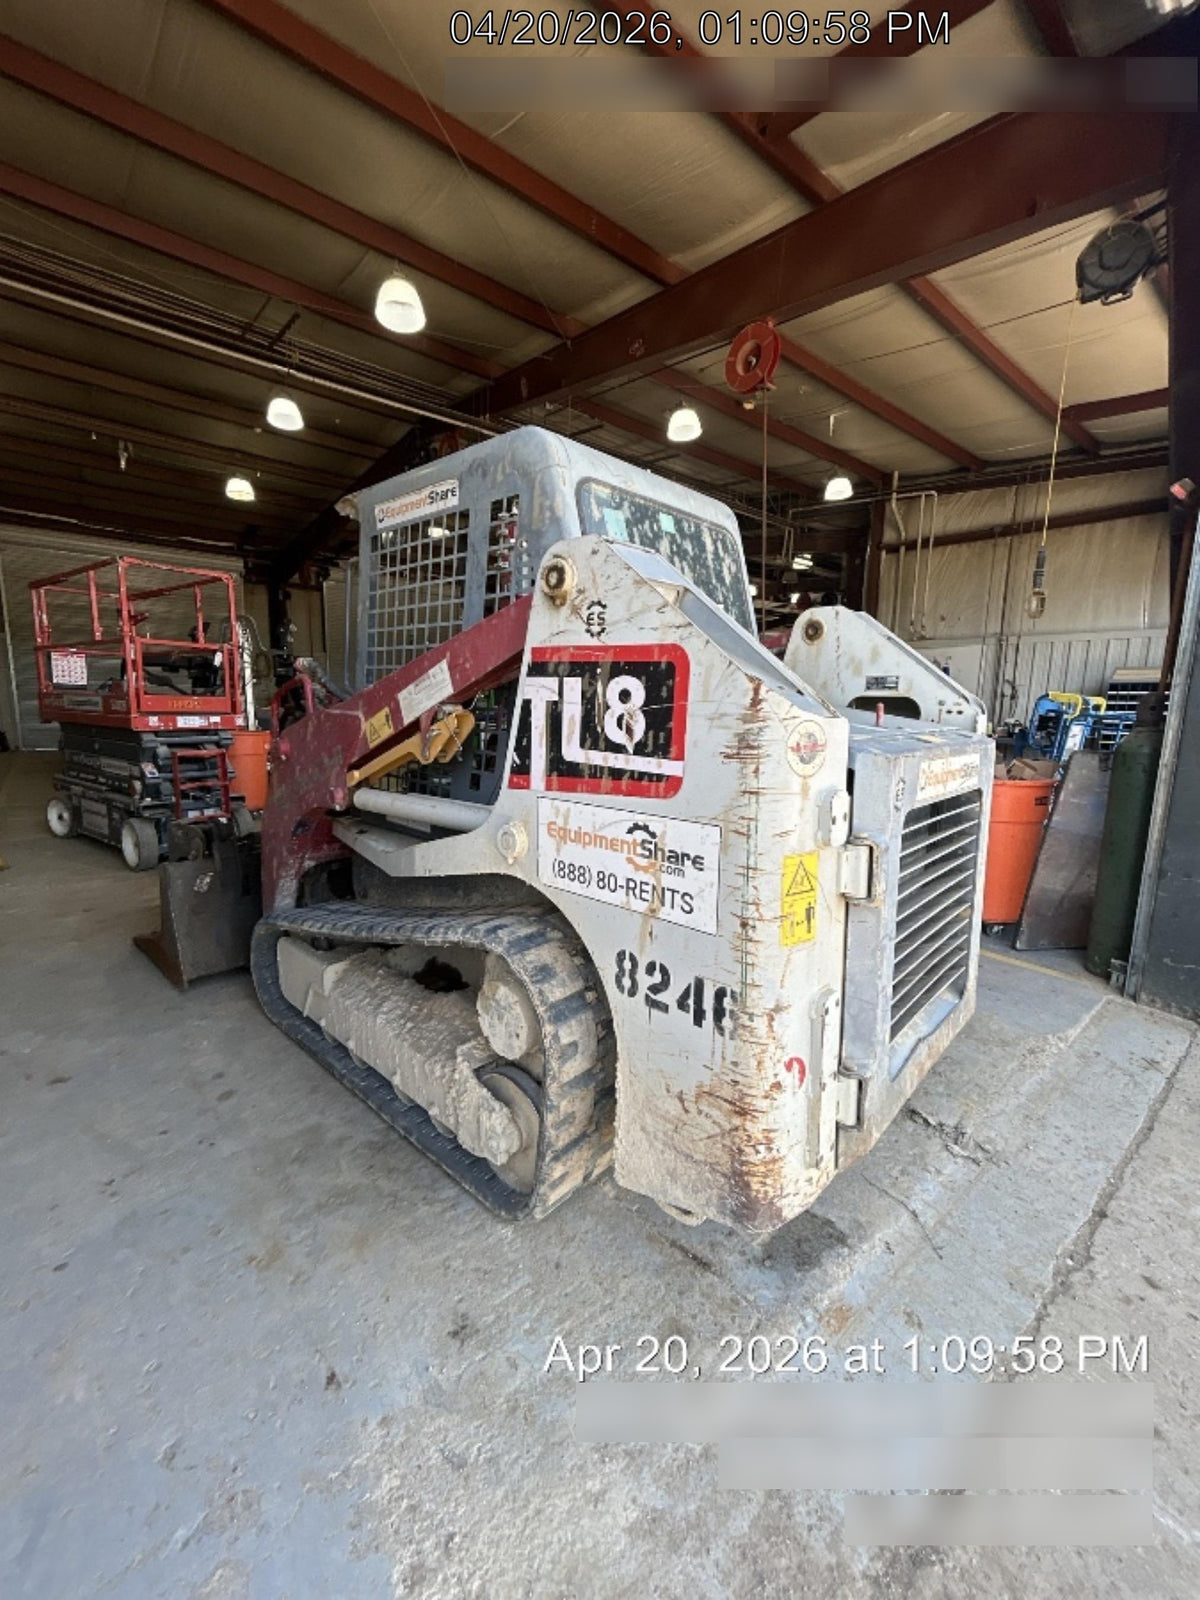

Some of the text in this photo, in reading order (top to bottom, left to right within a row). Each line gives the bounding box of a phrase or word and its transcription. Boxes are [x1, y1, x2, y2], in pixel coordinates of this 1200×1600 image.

[520, 674, 684, 791] TL8
[546, 820, 705, 872] EquipmentShare
[552, 857, 695, 915] (888) 80-RENTS
